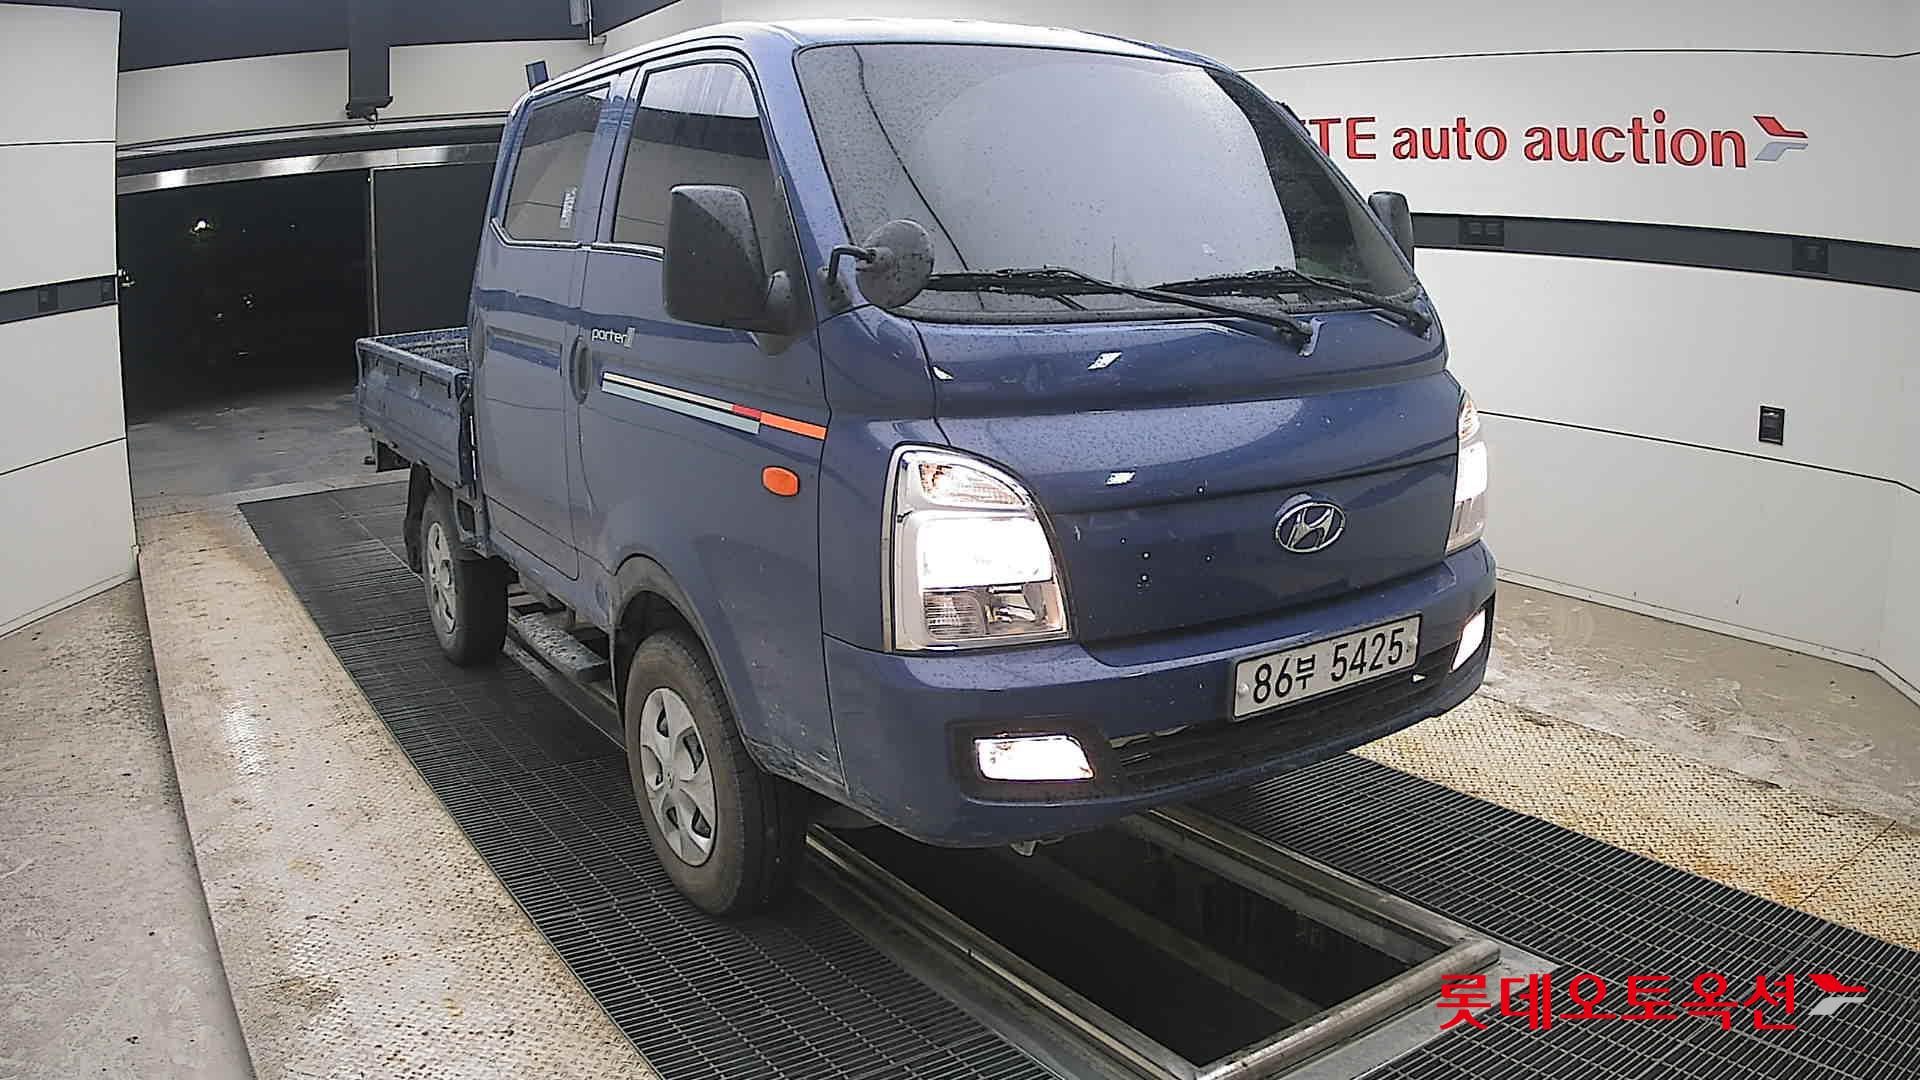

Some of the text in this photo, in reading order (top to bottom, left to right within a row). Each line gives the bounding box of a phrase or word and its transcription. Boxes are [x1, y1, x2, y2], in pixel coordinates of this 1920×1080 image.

[1300, 109, 1746, 168] TE auto auction
[1253, 627, 1405, 704] 86부 5425
